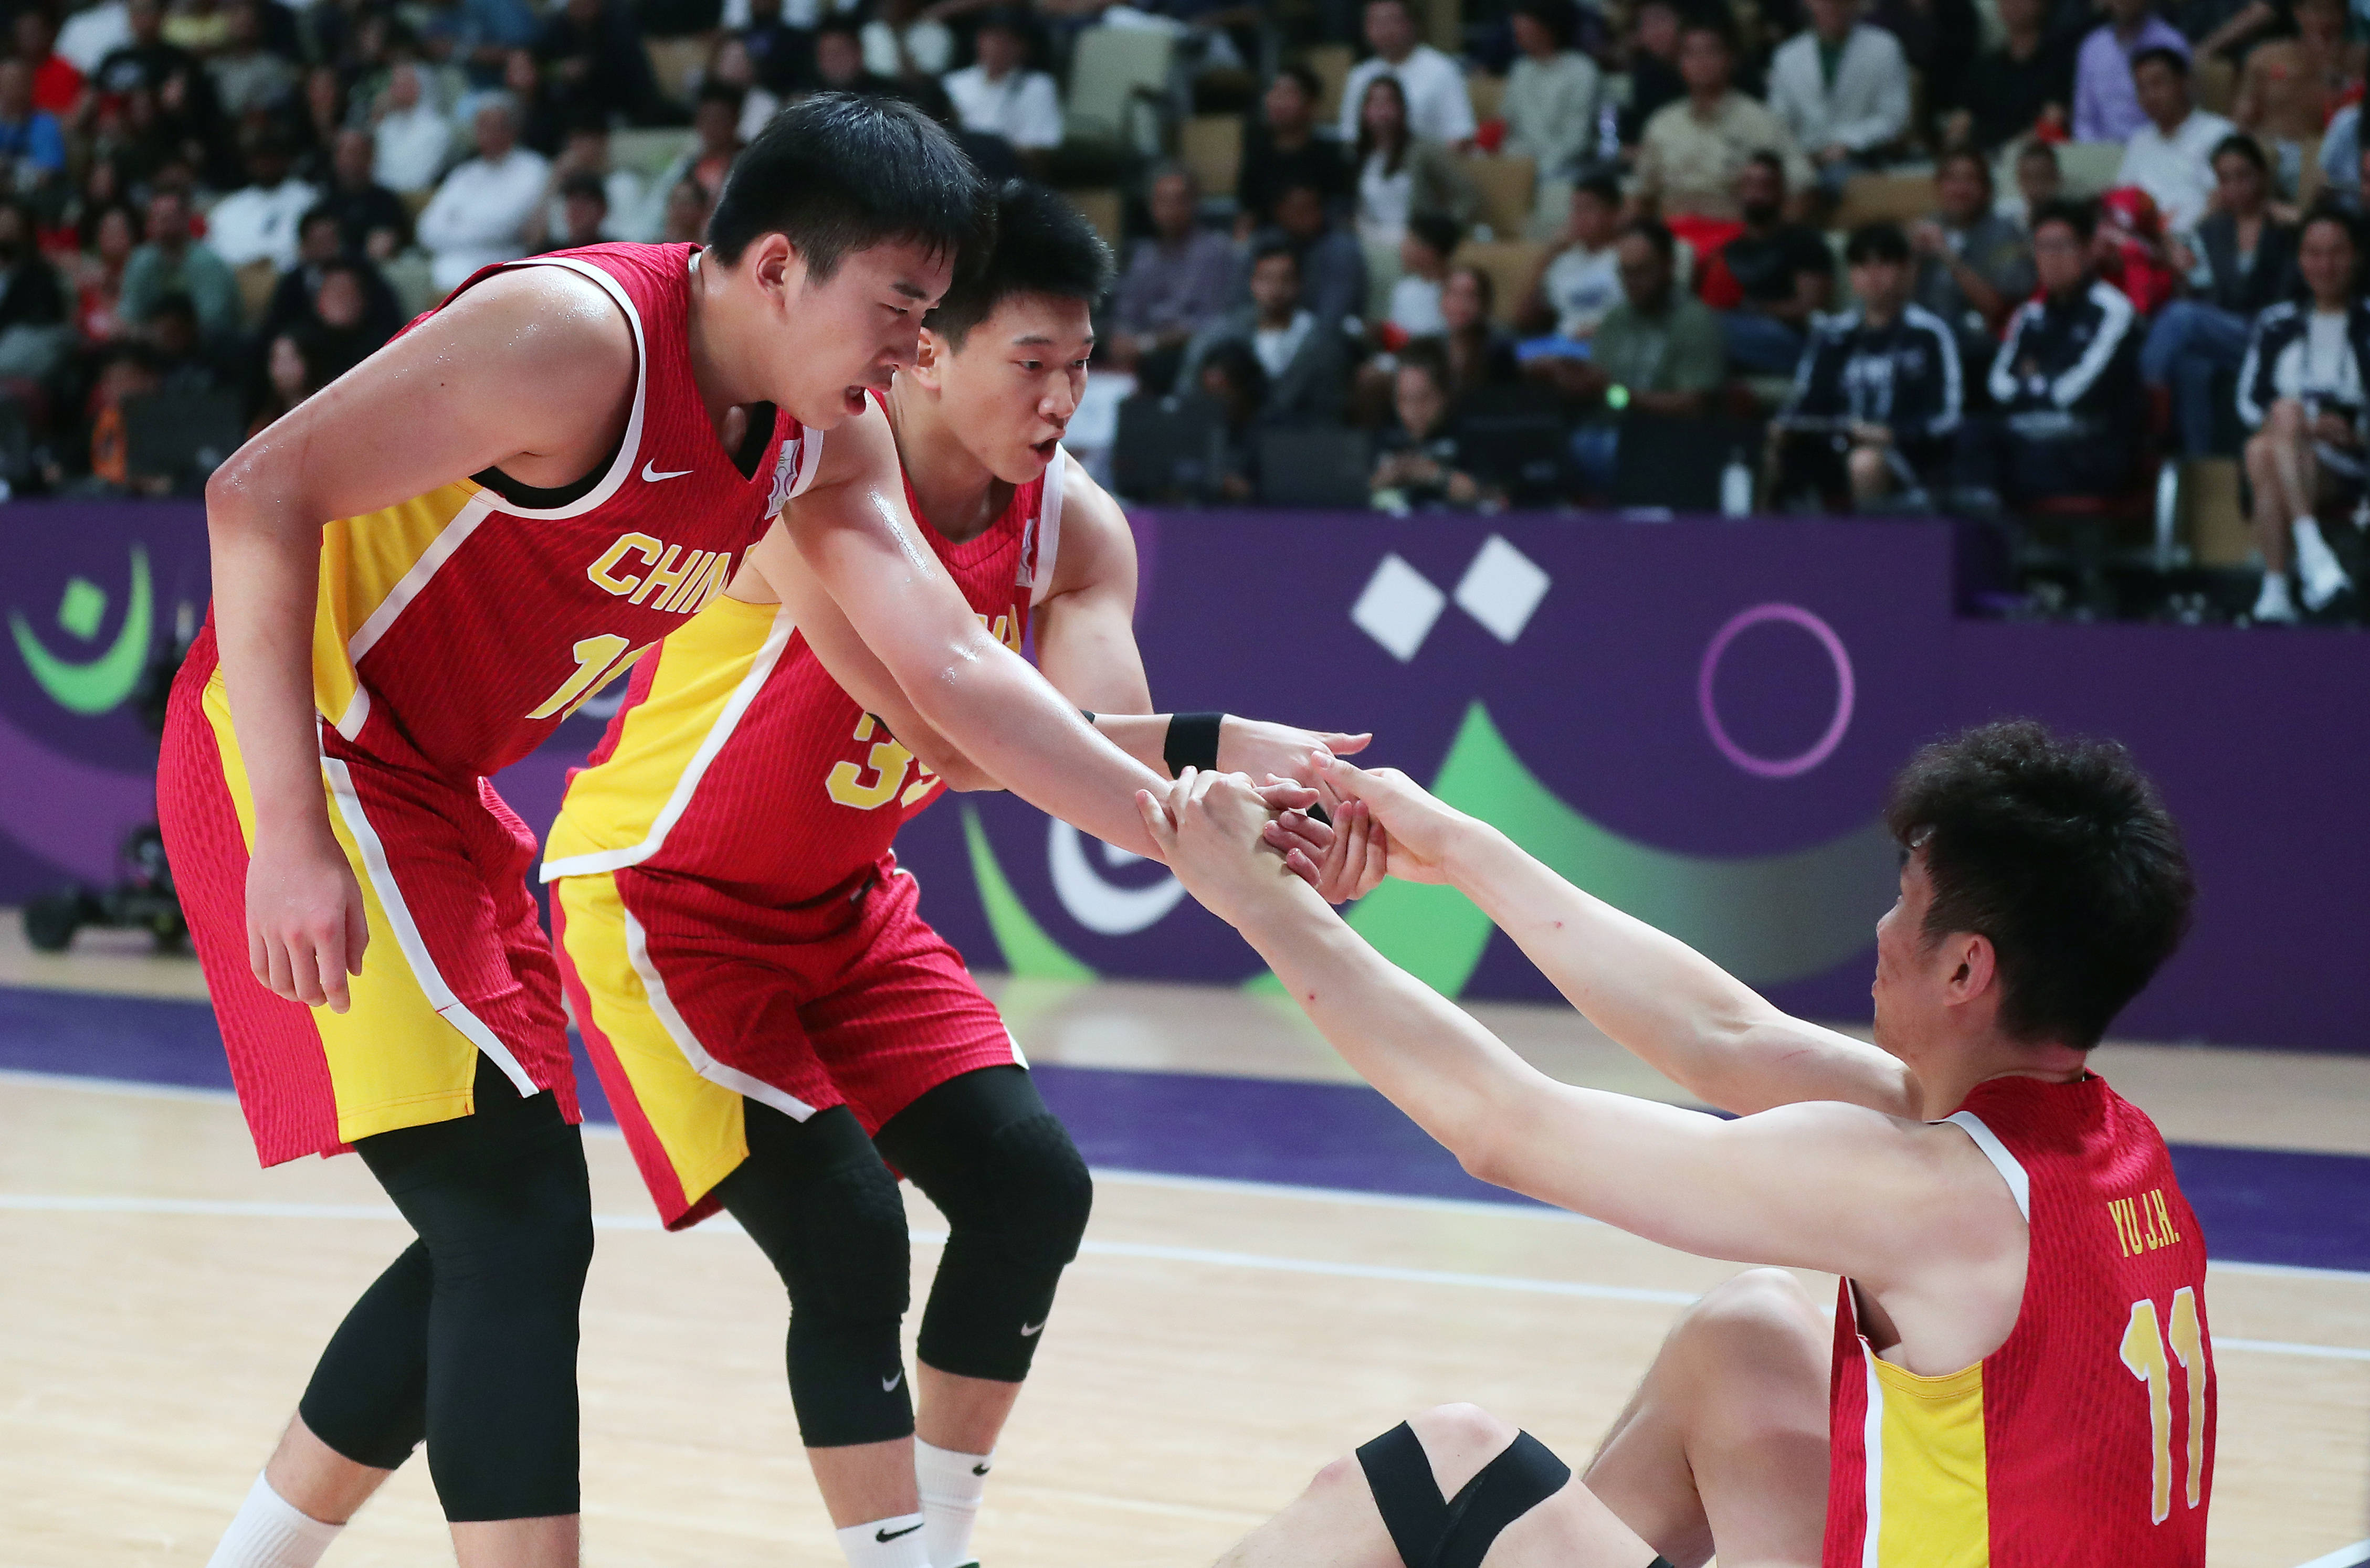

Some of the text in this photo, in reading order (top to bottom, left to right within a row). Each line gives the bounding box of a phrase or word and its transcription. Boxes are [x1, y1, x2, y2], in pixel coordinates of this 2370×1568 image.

[587, 532, 761, 614] CHIN
[2108, 1189, 2181, 1257] YU J.H.
[2119, 1286, 2207, 1525] 11
